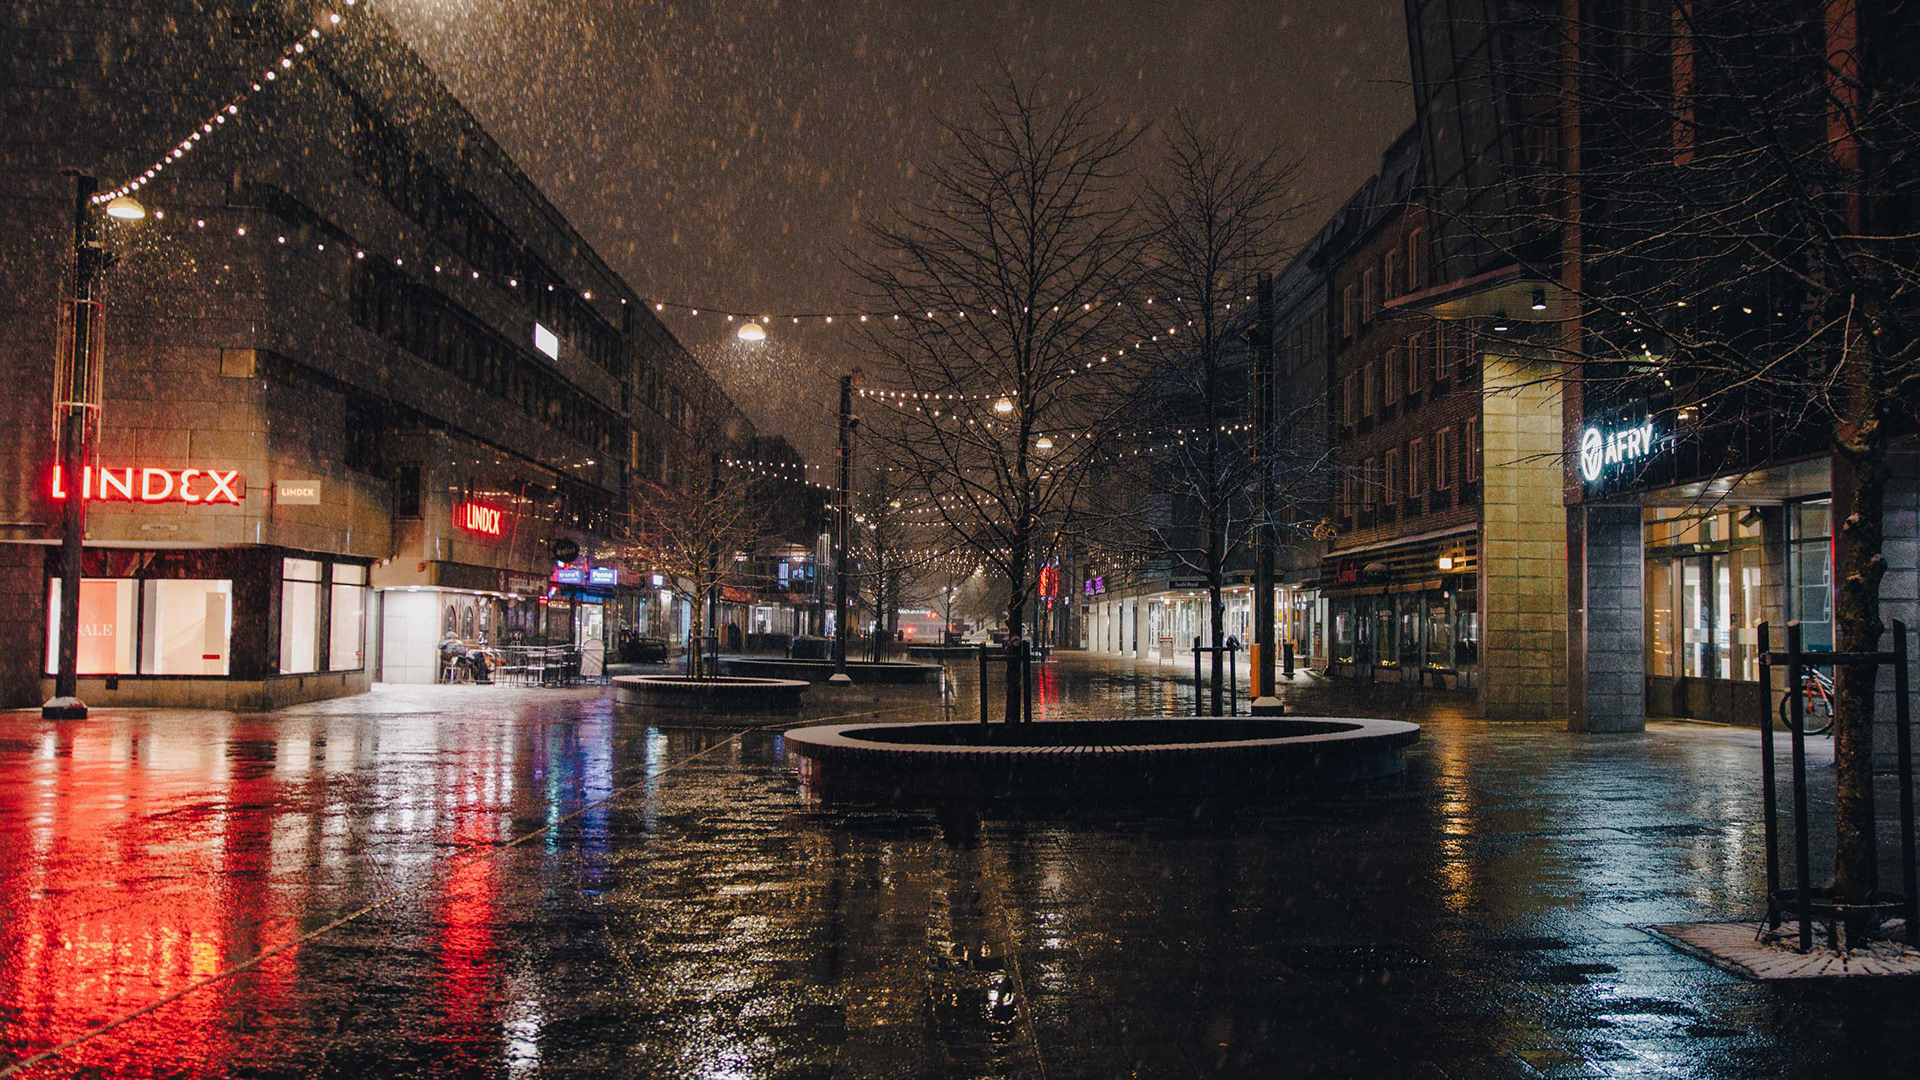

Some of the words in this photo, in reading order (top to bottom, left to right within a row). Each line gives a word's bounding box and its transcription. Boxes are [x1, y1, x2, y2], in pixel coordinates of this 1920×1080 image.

[1605, 423, 1653, 465] AFRY
[52, 465, 239, 503] LINDEX
[281, 488, 314, 497] LINDEX
[467, 503, 501, 535] LINDEX
